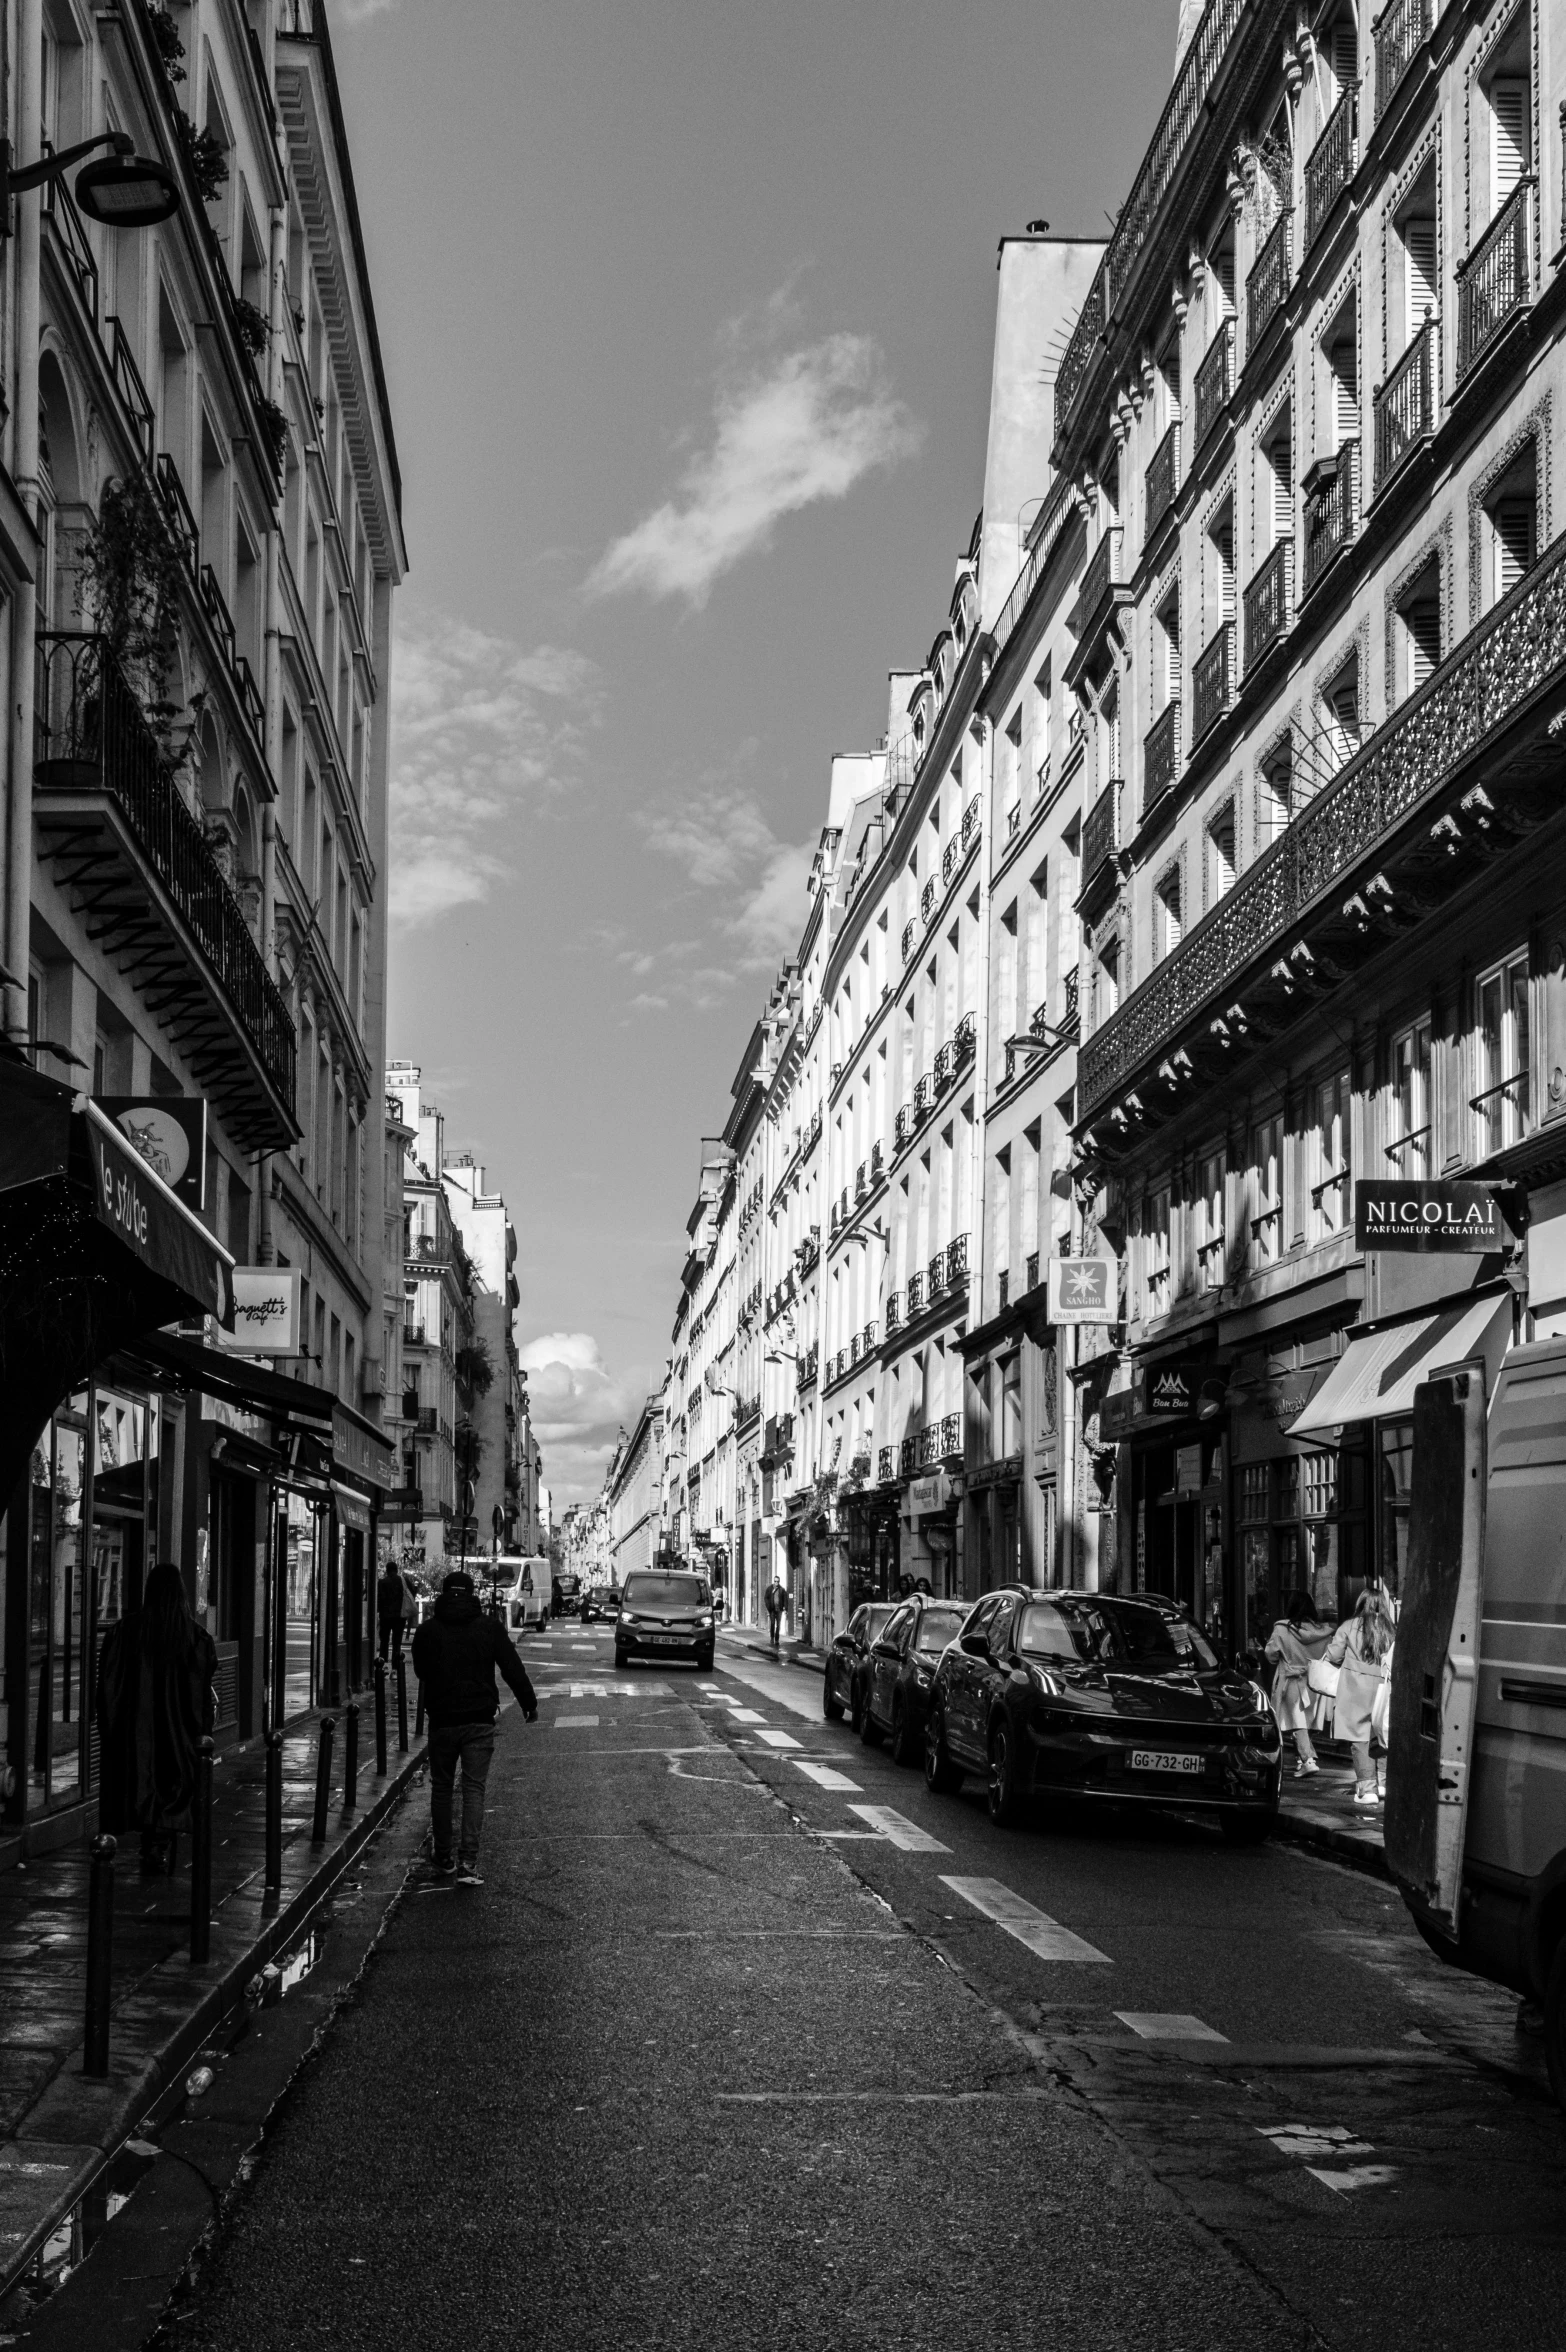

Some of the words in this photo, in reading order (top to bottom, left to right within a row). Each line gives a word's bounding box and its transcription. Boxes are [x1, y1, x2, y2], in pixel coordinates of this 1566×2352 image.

[115, 1173, 147, 1245] stube
[1367, 1199, 1495, 1223] NICOLAÏ
[1366, 1225, 1431, 1234] PARFUMEUR
[1066, 1296, 1101, 1305] SANGHO
[251, 1313, 270, 1326] Café
[1152, 1397, 1170, 1408] Ban
[1134, 1753, 1198, 1770] GG-732-GH
